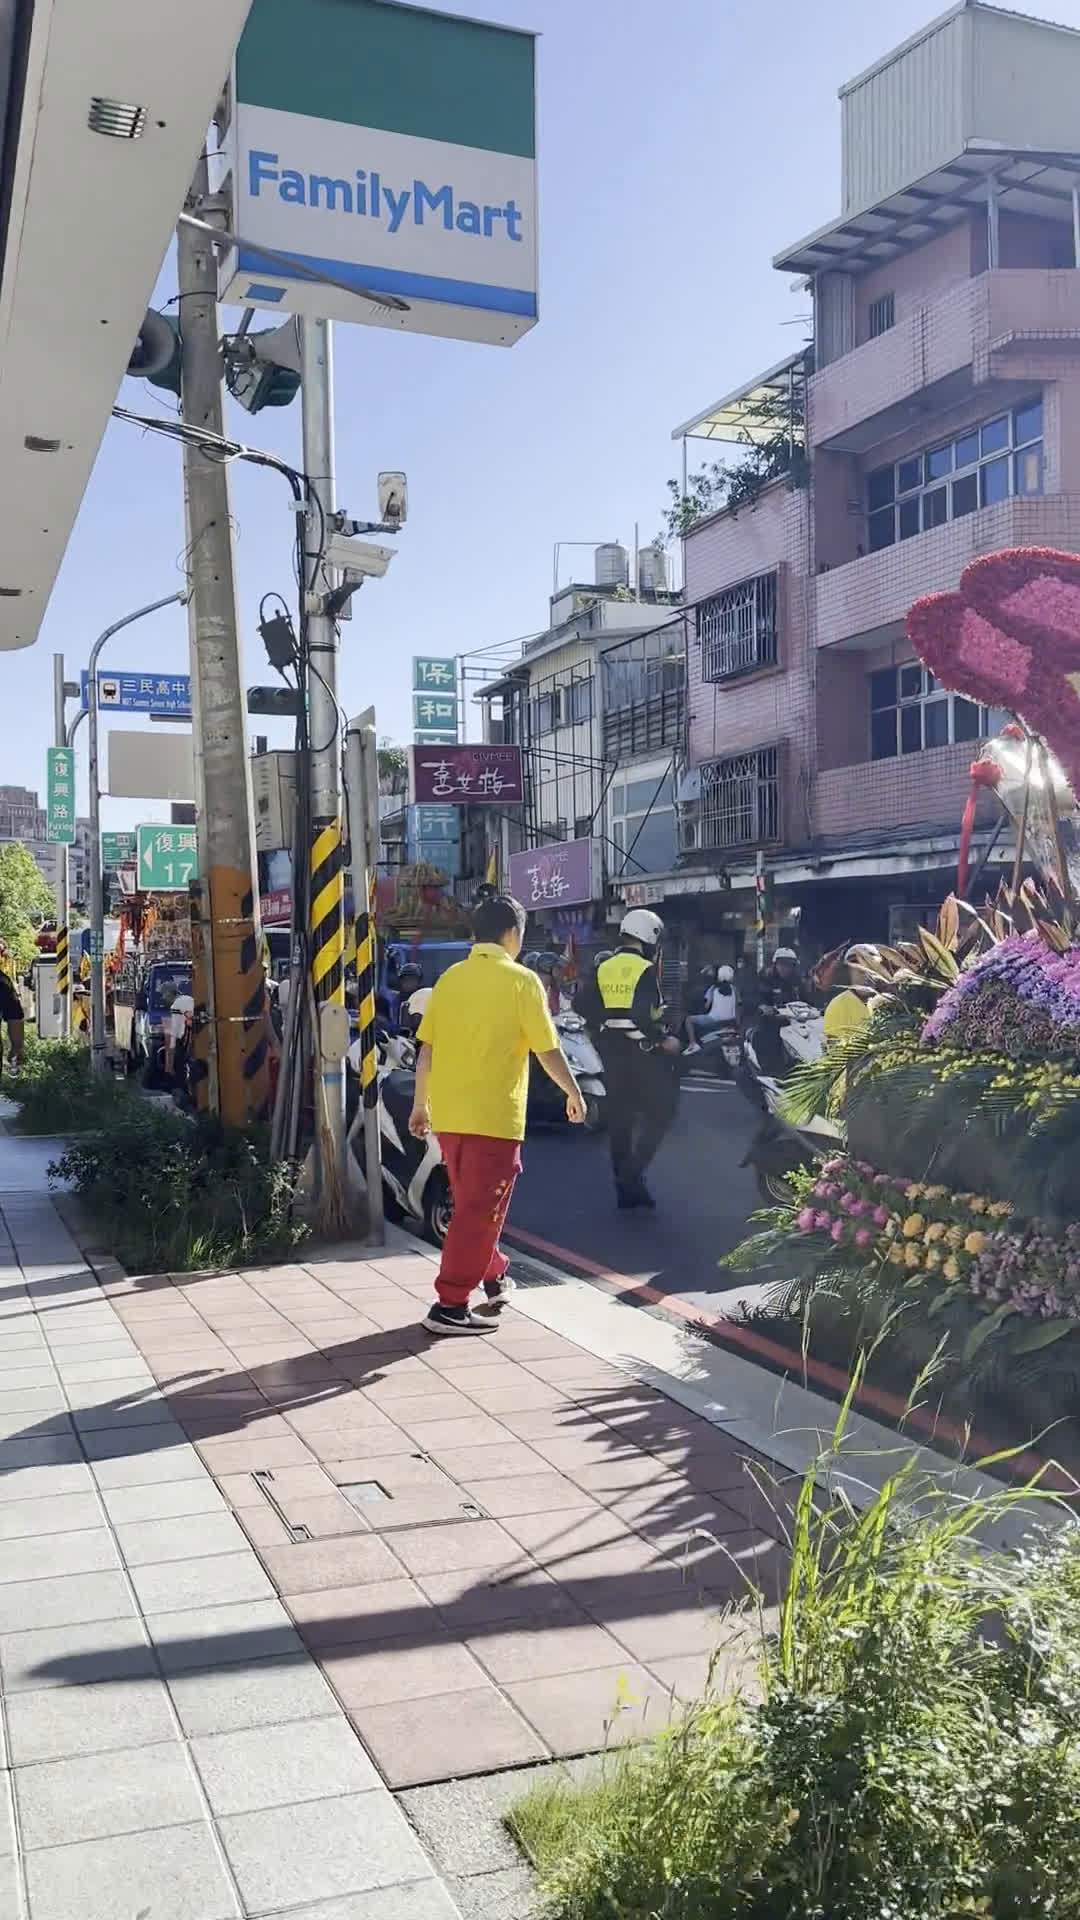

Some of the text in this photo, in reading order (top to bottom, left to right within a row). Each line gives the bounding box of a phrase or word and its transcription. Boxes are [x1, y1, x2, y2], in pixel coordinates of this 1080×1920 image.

[249, 150, 522, 242] FamilyMart
[54, 762, 69, 819] 復興路
[163, 863, 193, 883] 17
